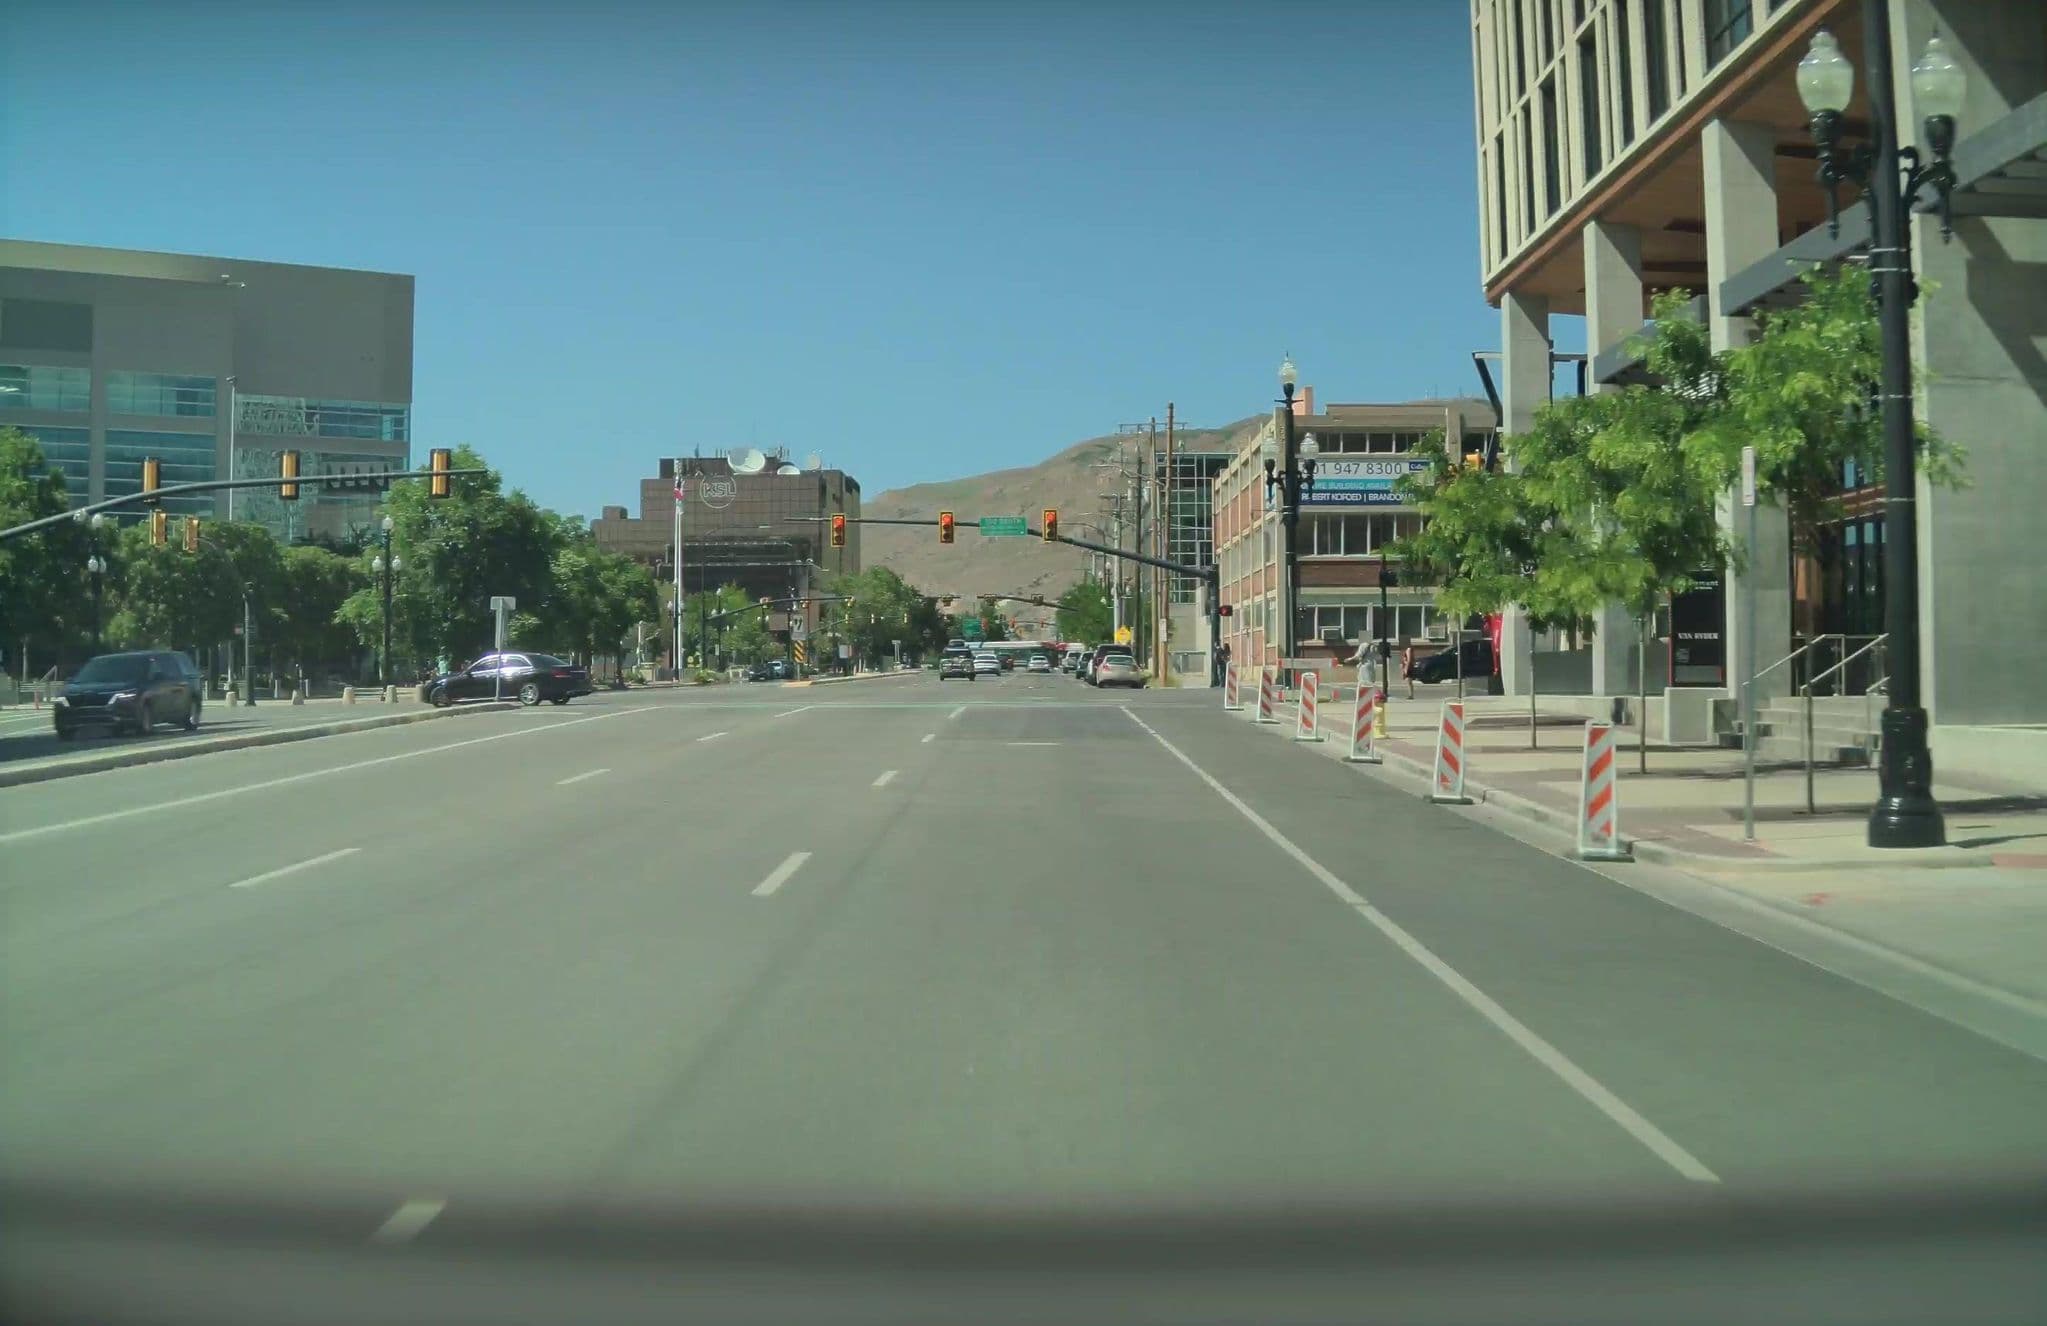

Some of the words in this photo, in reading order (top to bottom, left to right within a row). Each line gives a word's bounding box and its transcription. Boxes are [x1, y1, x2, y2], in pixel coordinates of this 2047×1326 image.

[1334, 463, 1361, 475] 947
[1366, 463, 1402, 475] 8300
[703, 482, 736, 498] KSL
